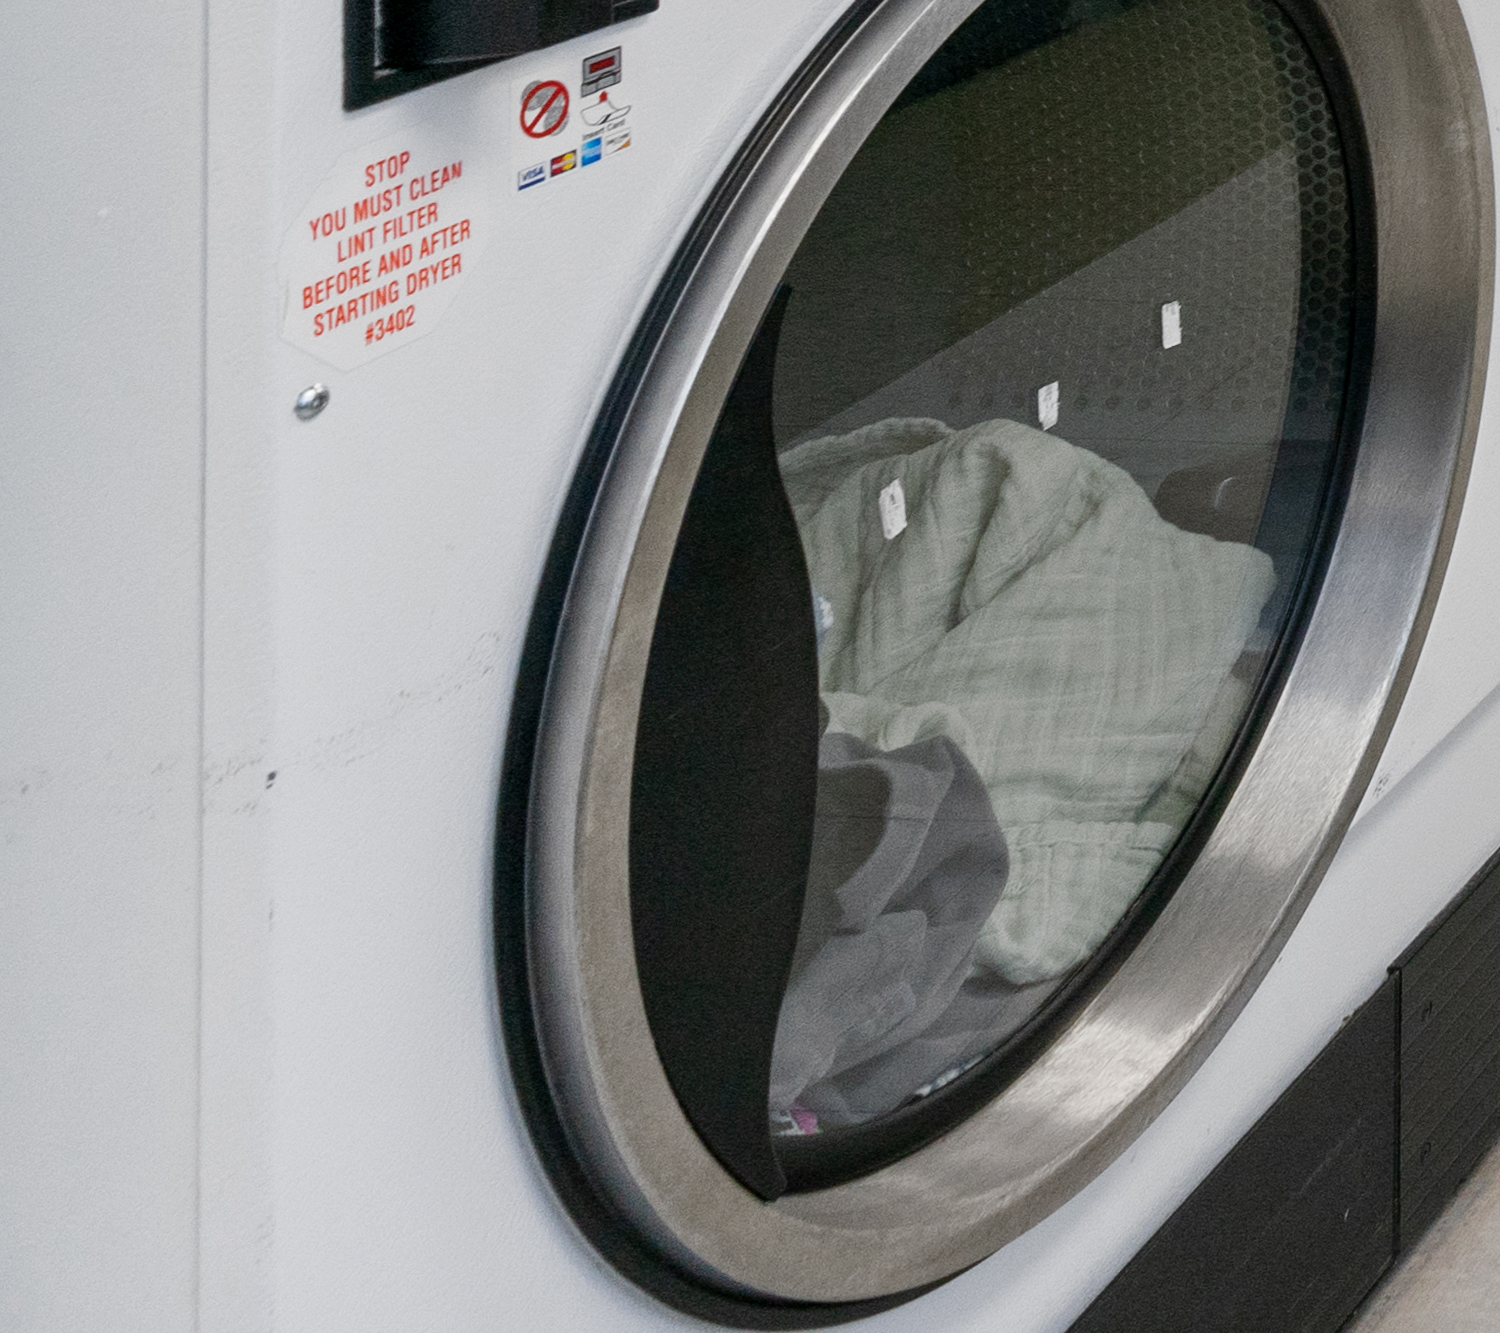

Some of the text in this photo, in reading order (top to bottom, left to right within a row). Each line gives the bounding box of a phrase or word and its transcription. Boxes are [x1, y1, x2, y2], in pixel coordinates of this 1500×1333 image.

[308, 159, 463, 242] YOU MUST CLEAN
[365, 150, 411, 188] STOP
[302, 218, 471, 310] BEFORE AND AFTER
[336, 201, 438, 263] LINT FILTER
[313, 252, 463, 337] STARTING DRYER
[364, 304, 416, 346] #3402
